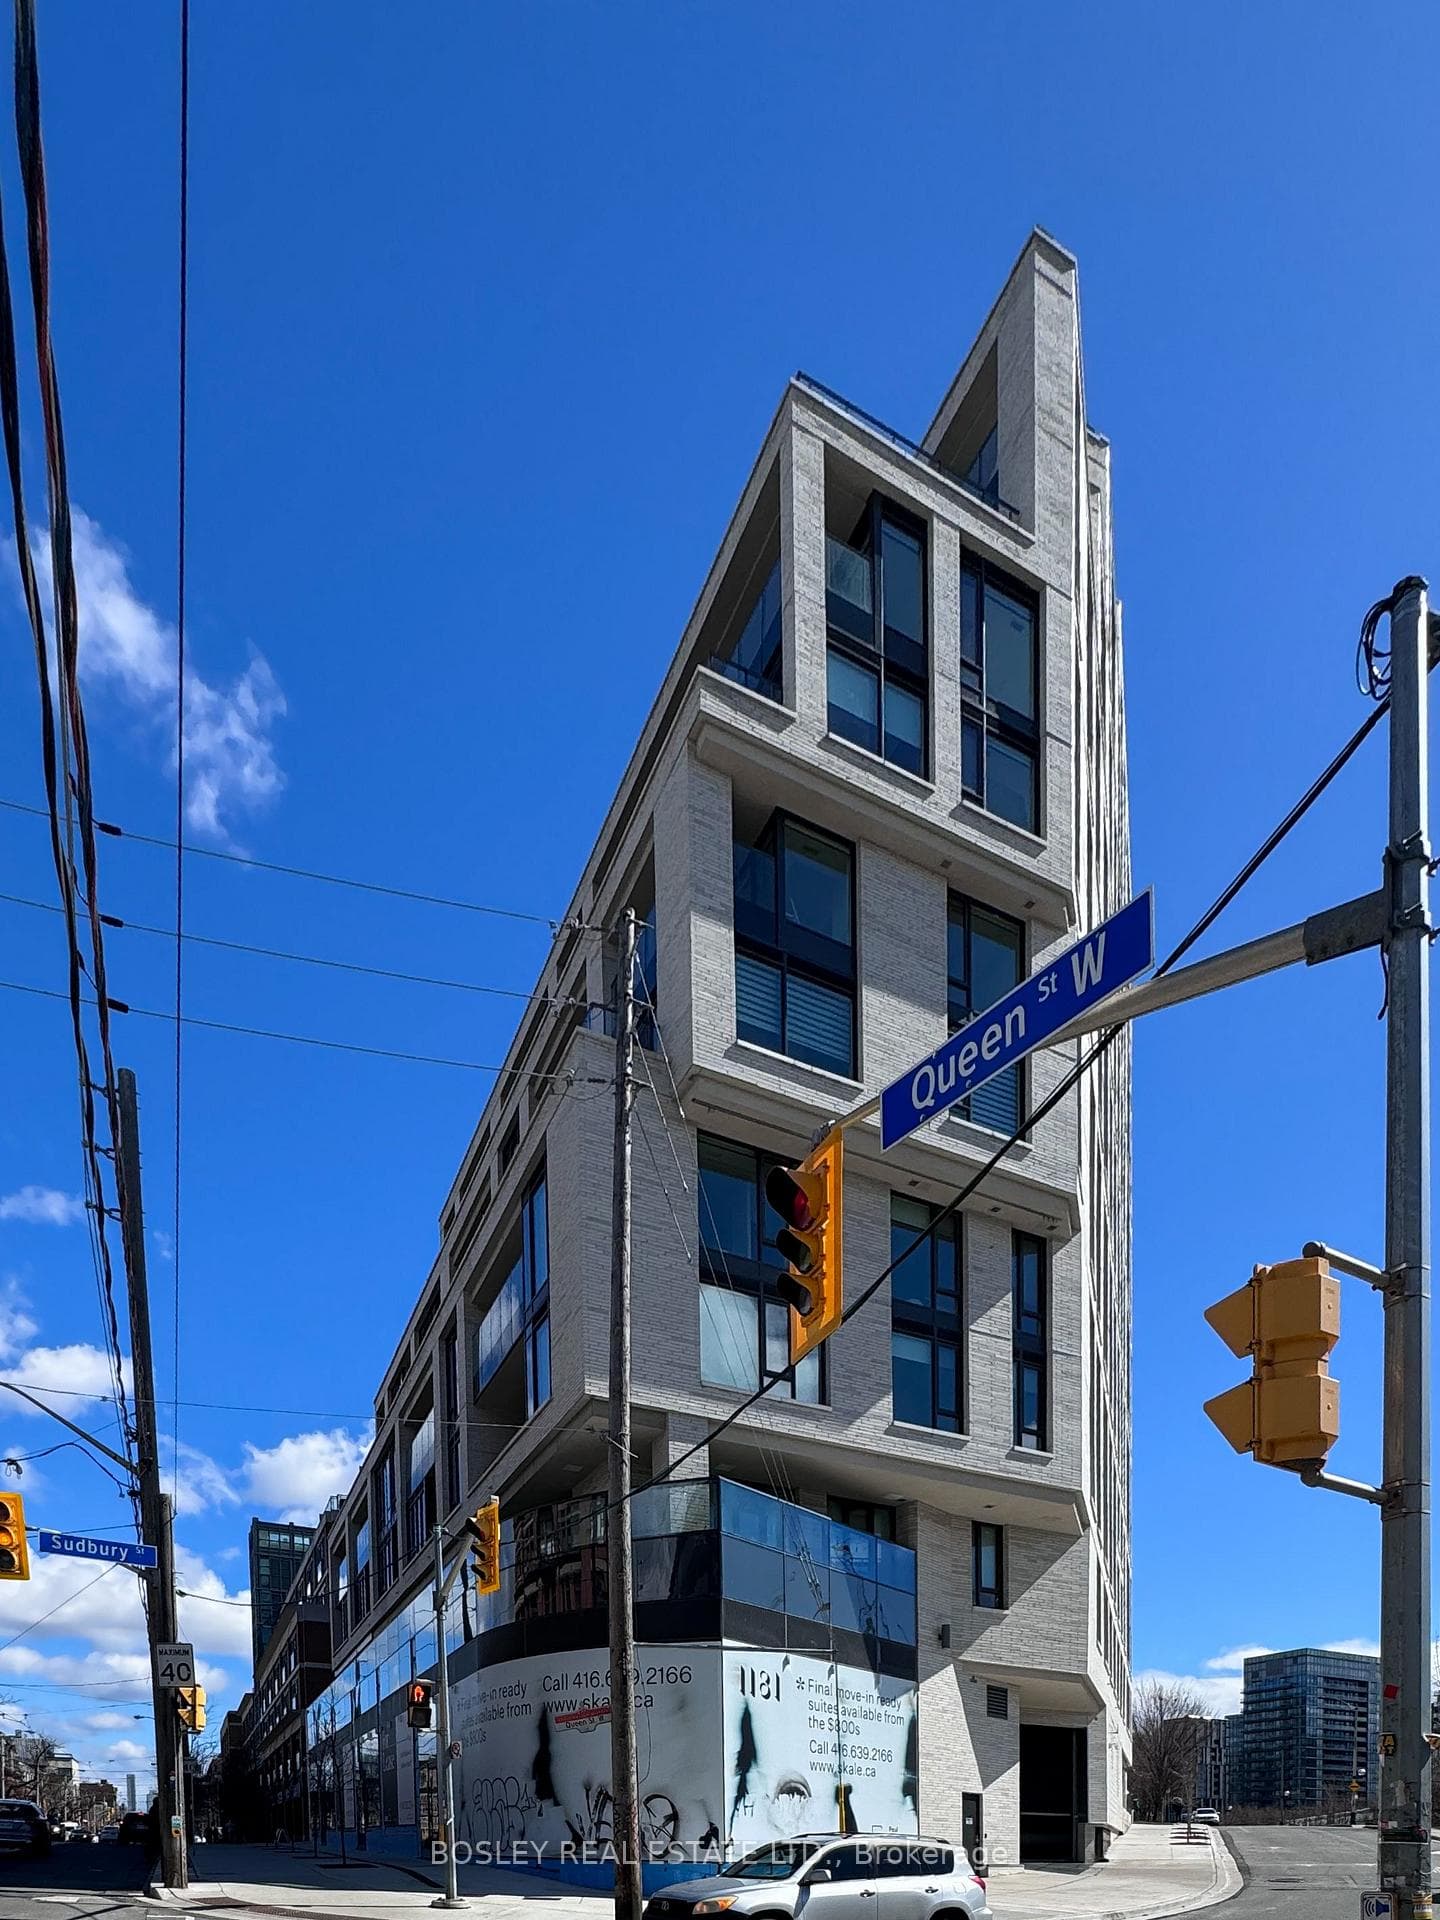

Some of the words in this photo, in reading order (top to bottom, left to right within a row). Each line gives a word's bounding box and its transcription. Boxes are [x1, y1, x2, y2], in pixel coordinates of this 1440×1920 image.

[911, 1004, 1026, 1110] Queen
[1038, 971, 1058, 1003] St
[1071, 931, 1107, 997] W
[51, 1536, 129, 1561] Sudbury
[136, 1546, 145, 1555] St
[160, 1662, 192, 1682] 40
[542, 1675, 569, 1693] Call
[572, 1666, 692, 1689] 416.69.2166
[739, 1665, 781, 1702] 1181
[499, 1680, 527, 1699] ready
[808, 1678, 833, 1695] Final
[837, 1688, 874, 1704] move-in
[876, 1695, 902, 1711] ready
[507, 1702, 532, 1718] from
[808, 1700, 838, 1715] suites
[841, 1705, 882, 1722] available
[884, 1712, 905, 1726] from
[808, 1715, 826, 1730] the
[828, 1718, 861, 1736] $800s
[809, 1739, 829, 1755] Call
[809, 1760, 876, 1778] www.skale.ca
